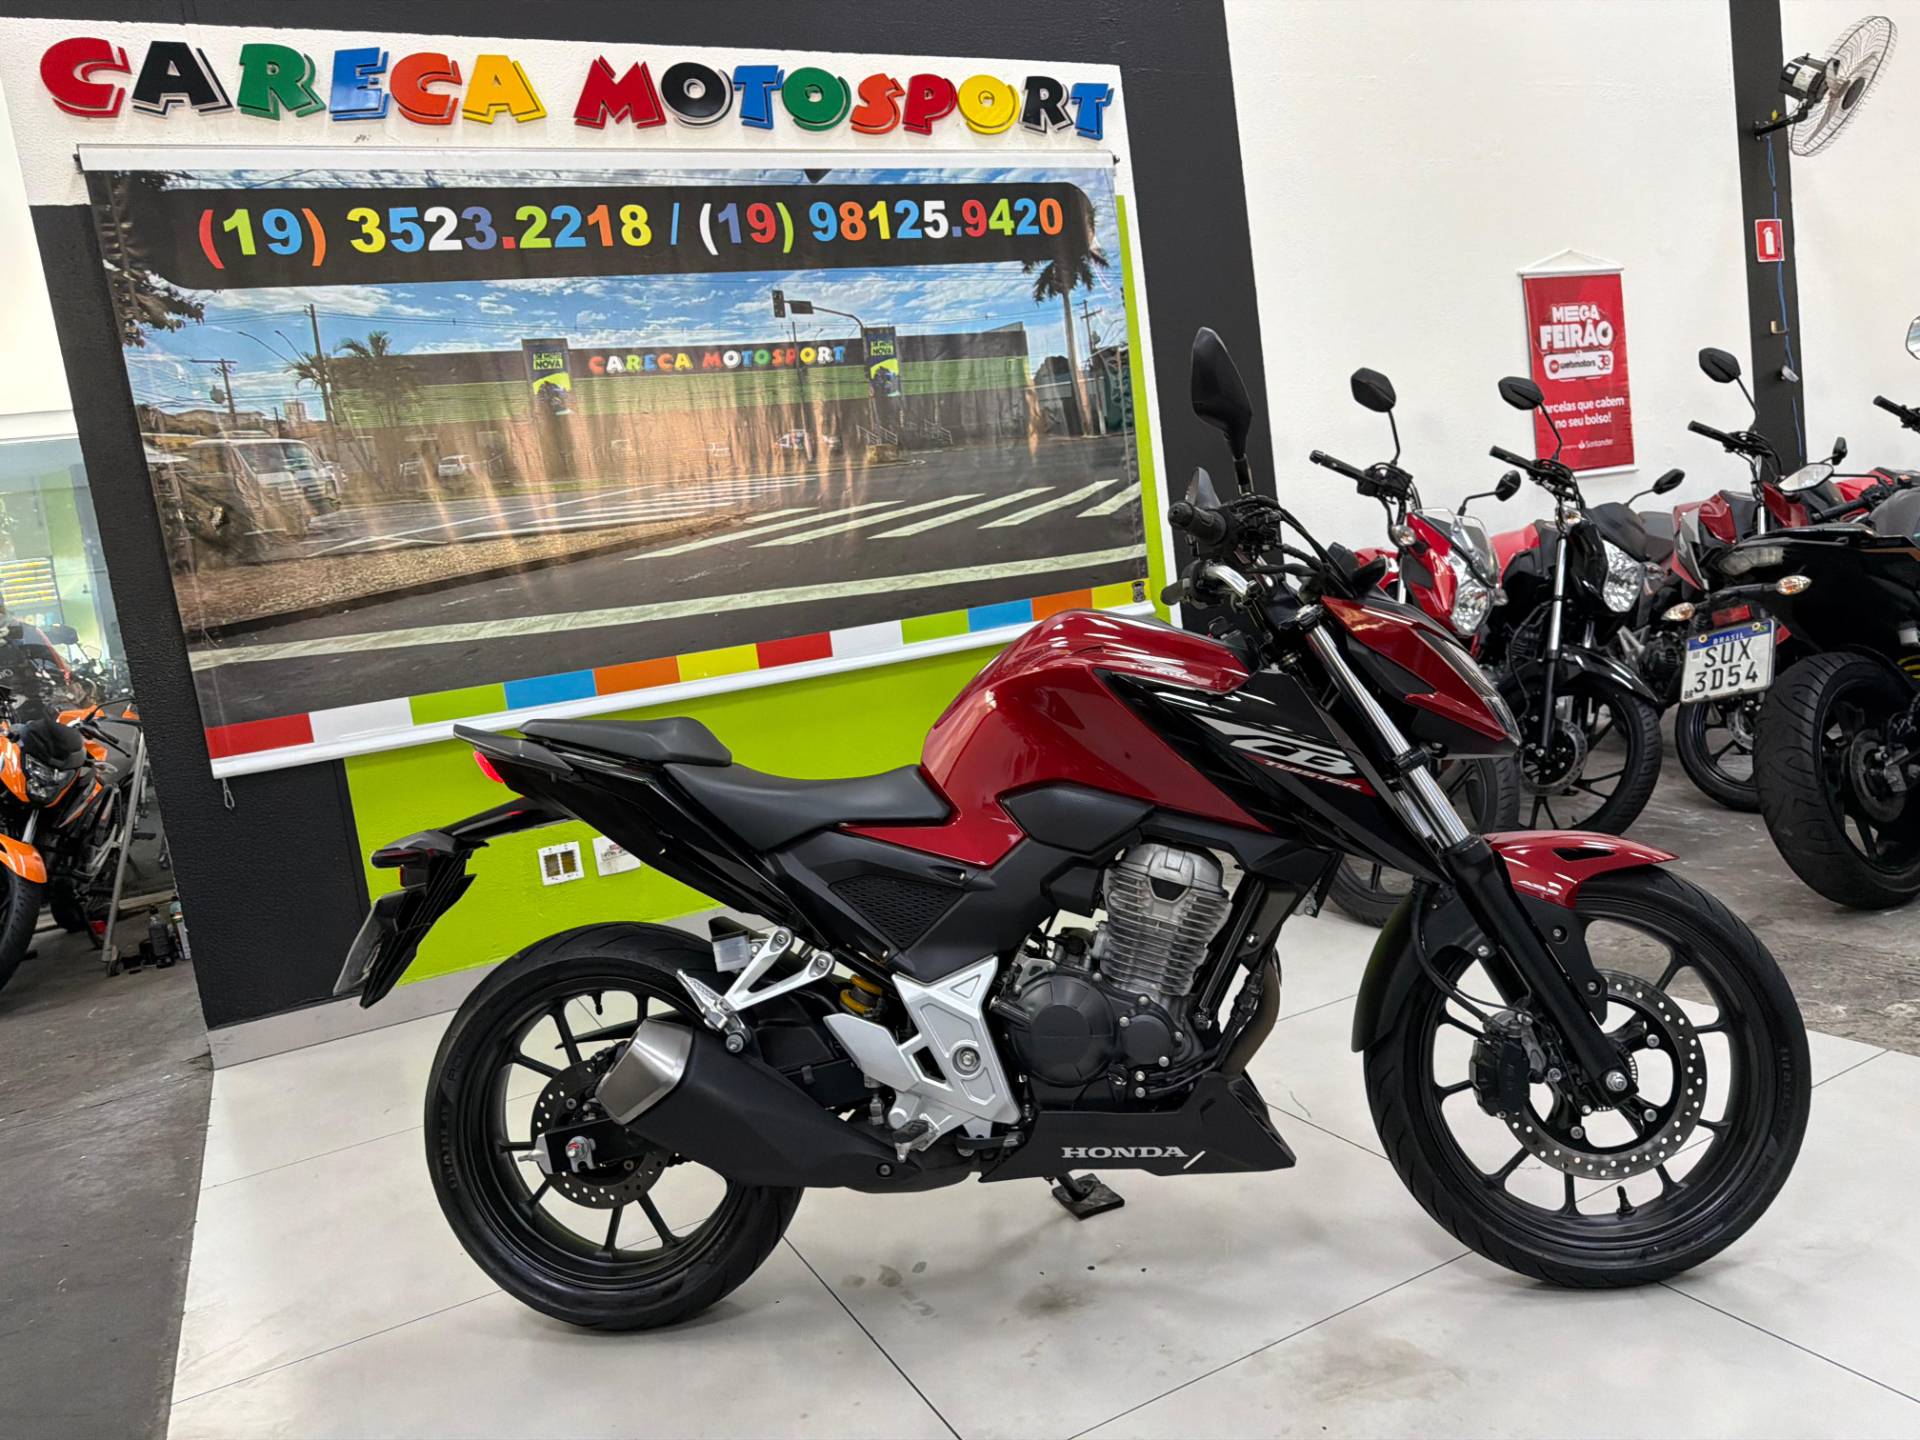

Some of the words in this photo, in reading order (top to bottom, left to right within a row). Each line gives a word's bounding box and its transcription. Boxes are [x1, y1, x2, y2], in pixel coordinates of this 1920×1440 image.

[40, 36, 547, 124] CARECA
[573, 54, 1113, 140] MOTOSPORT
[199, 207, 327, 269] (19)
[346, 203, 652, 255] 3523.2218
[699, 202, 795, 257] (19)
[808, 197, 1064, 244] 98125.9420
[1552, 304, 1600, 324] MEGA
[1540, 318, 1613, 350] FEIRÃO
[588, 352, 694, 375] CARECA
[702, 345, 846, 369] MOTOSPORT
[1577, 401, 1594, 413] que
[1595, 396, 1625, 409] cabem
[1555, 419, 1567, 429] no
[1568, 417, 1584, 428] seu
[1585, 412, 1612, 426] bolso!
[1704, 638, 1752, 669] SUX
[1713, 632, 1744, 645] BRASIL
[1694, 661, 1758, 693] 3D54
[1061, 1146, 1189, 1159] HONDA
